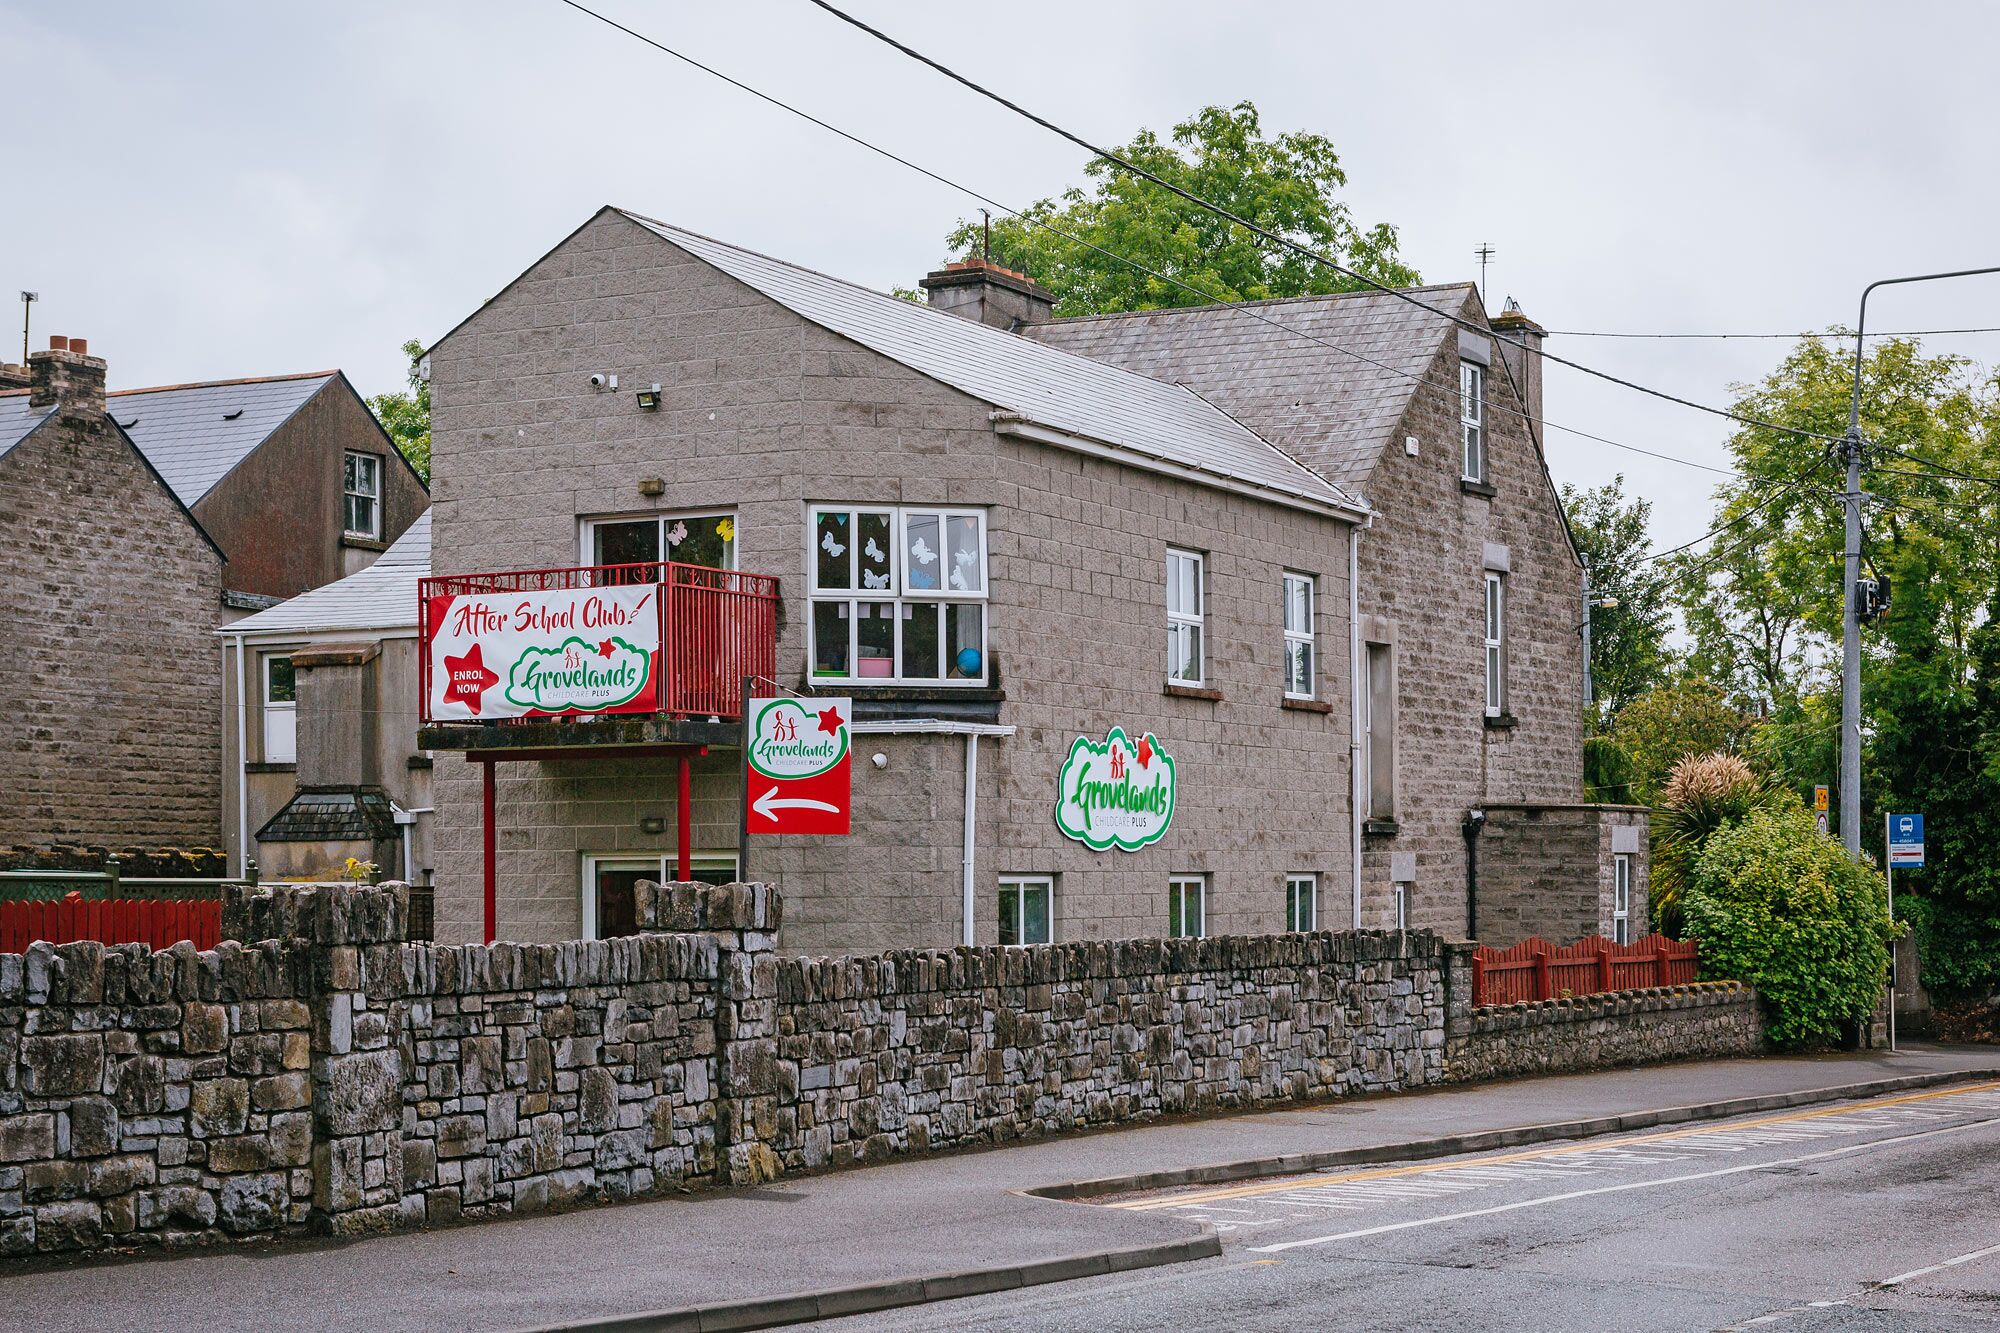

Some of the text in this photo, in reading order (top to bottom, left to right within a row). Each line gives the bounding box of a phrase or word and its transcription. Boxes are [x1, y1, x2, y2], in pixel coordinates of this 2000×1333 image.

[453, 602, 508, 638] After
[514, 601, 575, 634] School
[453, 669, 484, 681] ENROL
[520, 660, 636, 702] Grovelands
[456, 683, 480, 694] NOW
[547, 689, 610, 699] CHILDCARE PLUS
[757, 738, 834, 765] Grovelands
[1071, 761, 1167, 831] Grovelands
[1095, 815, 1147, 827] CHILDCARE PLUS
